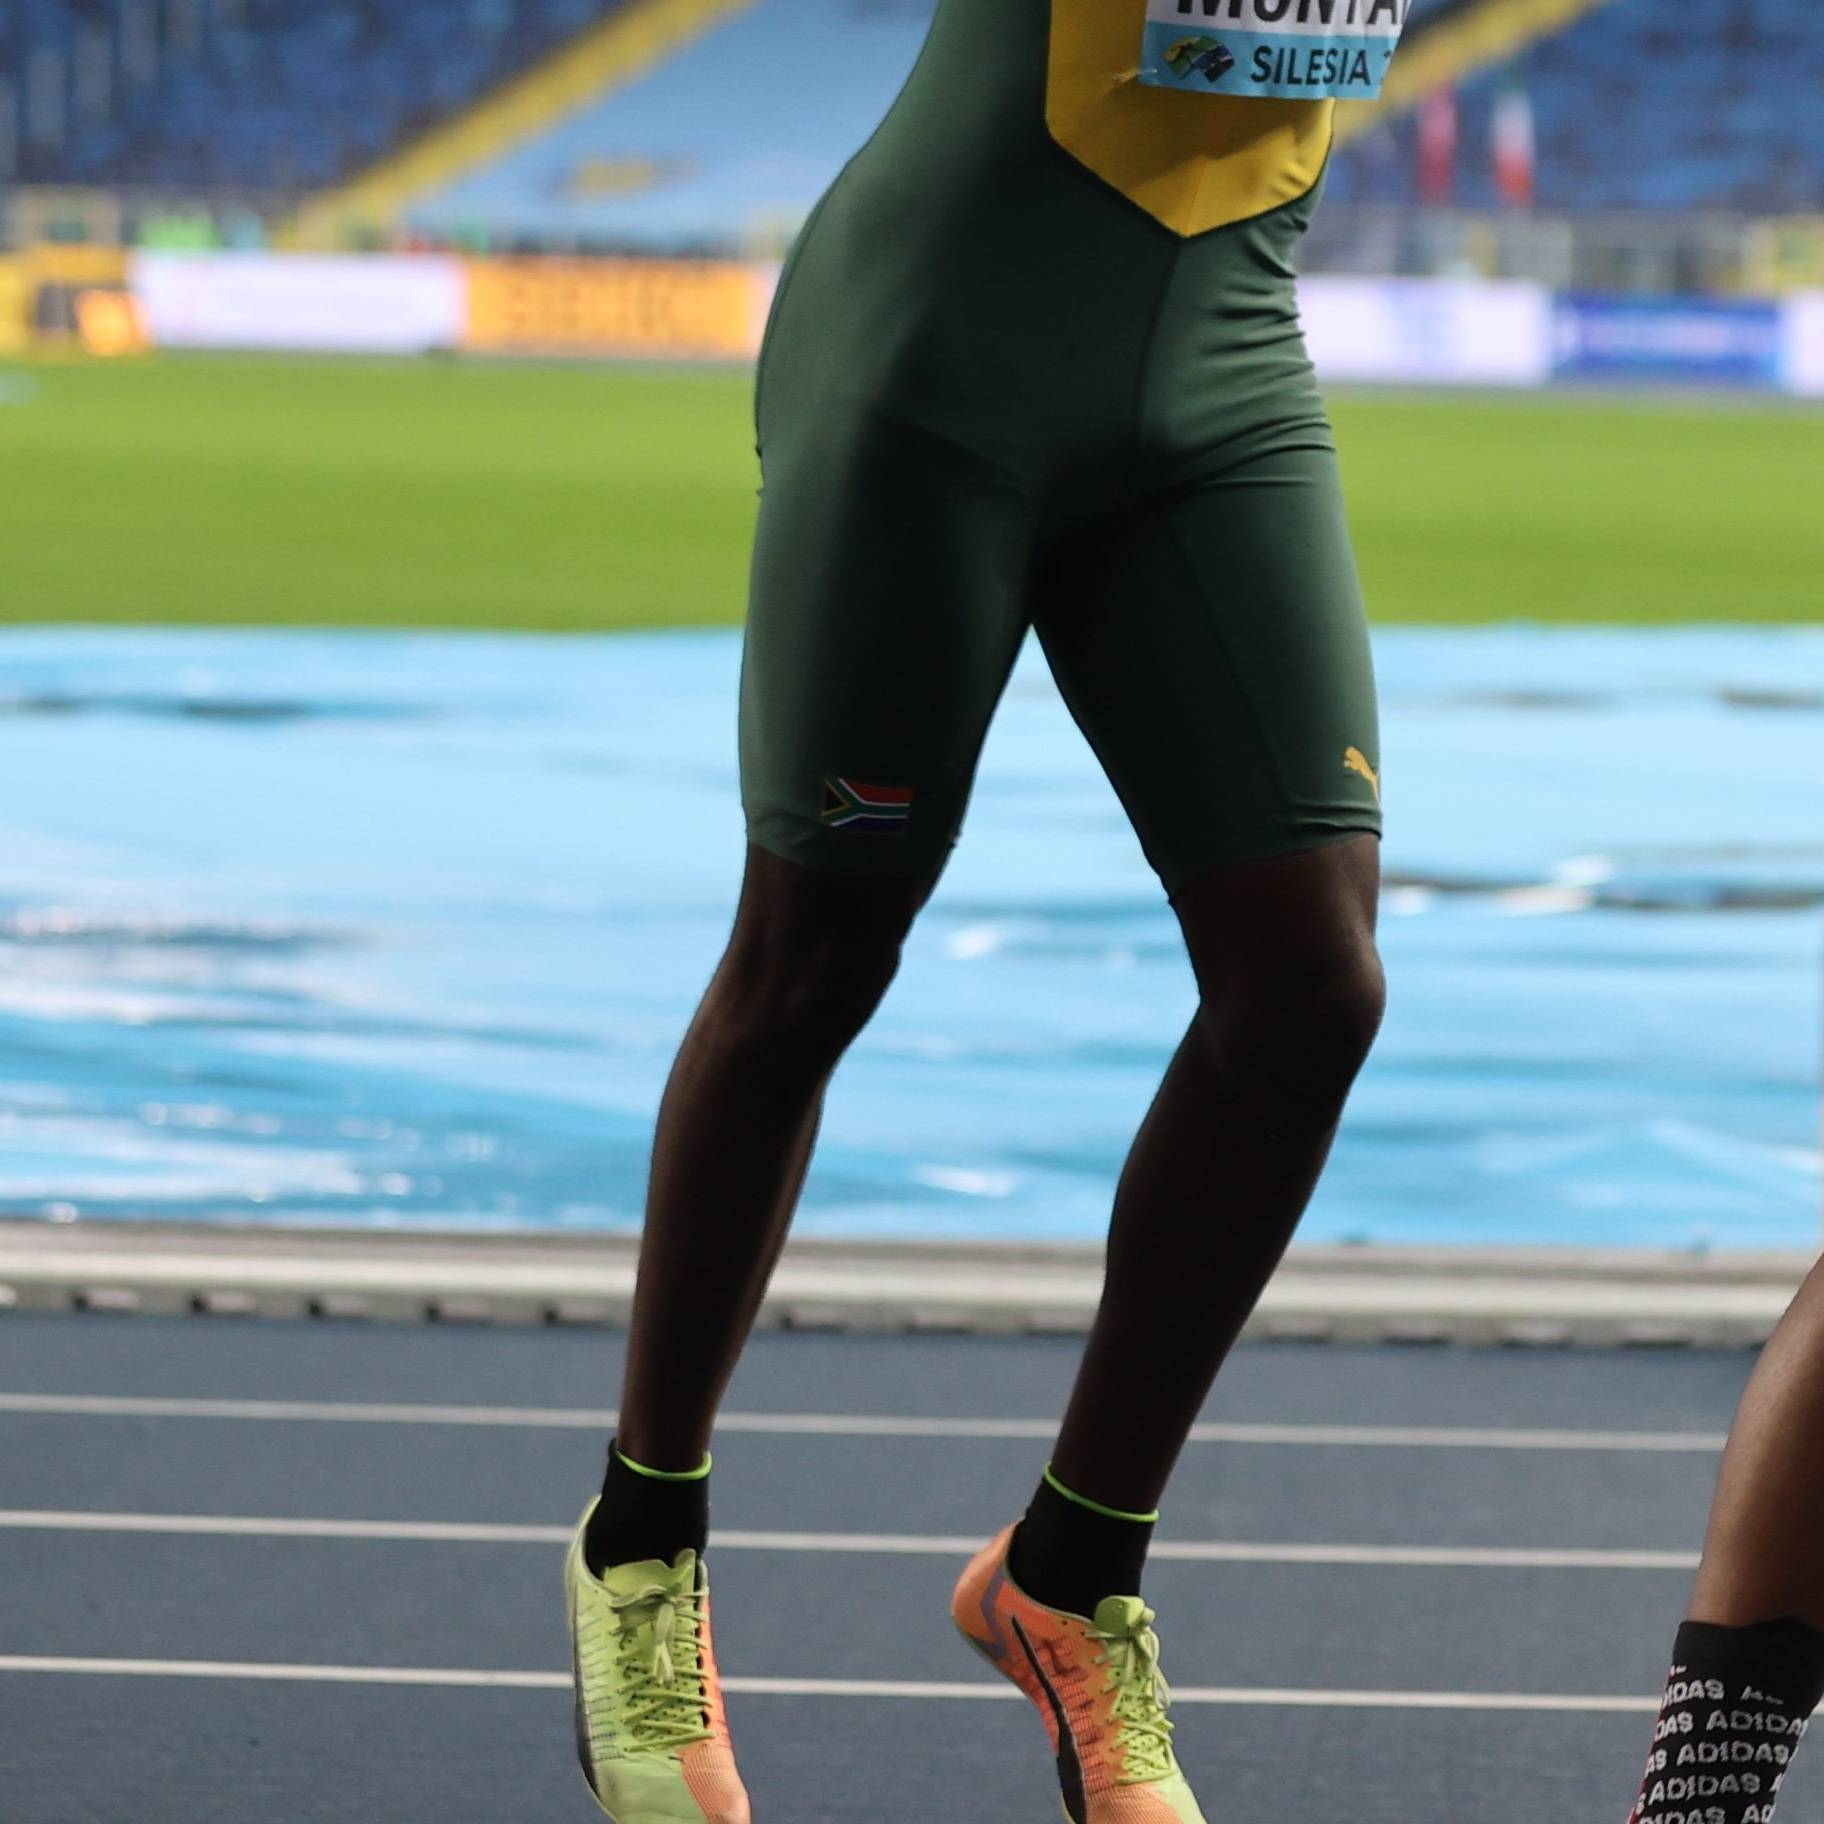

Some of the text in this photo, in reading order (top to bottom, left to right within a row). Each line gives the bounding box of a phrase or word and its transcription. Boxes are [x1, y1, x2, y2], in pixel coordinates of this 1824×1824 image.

[1249, 44, 1372, 86] SILESIA
[1676, 1739, 1790, 1767] ADIDAS
[1648, 1772, 1761, 1806] ADIDAS
